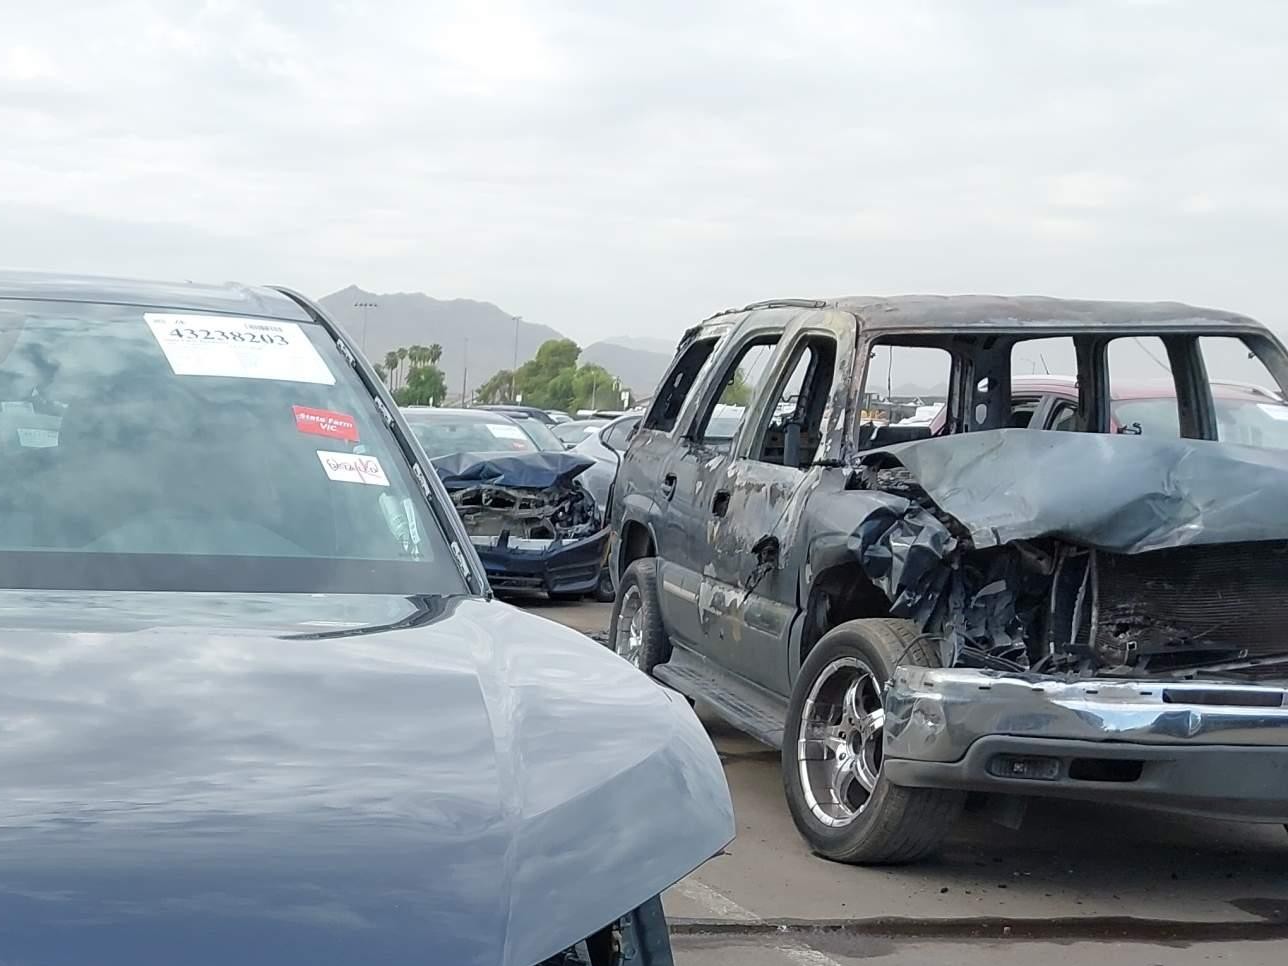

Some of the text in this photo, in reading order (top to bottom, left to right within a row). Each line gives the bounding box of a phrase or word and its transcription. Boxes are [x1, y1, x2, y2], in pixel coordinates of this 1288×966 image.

[168, 327, 290, 346] 43238203
[298, 412, 353, 429] State Farm
